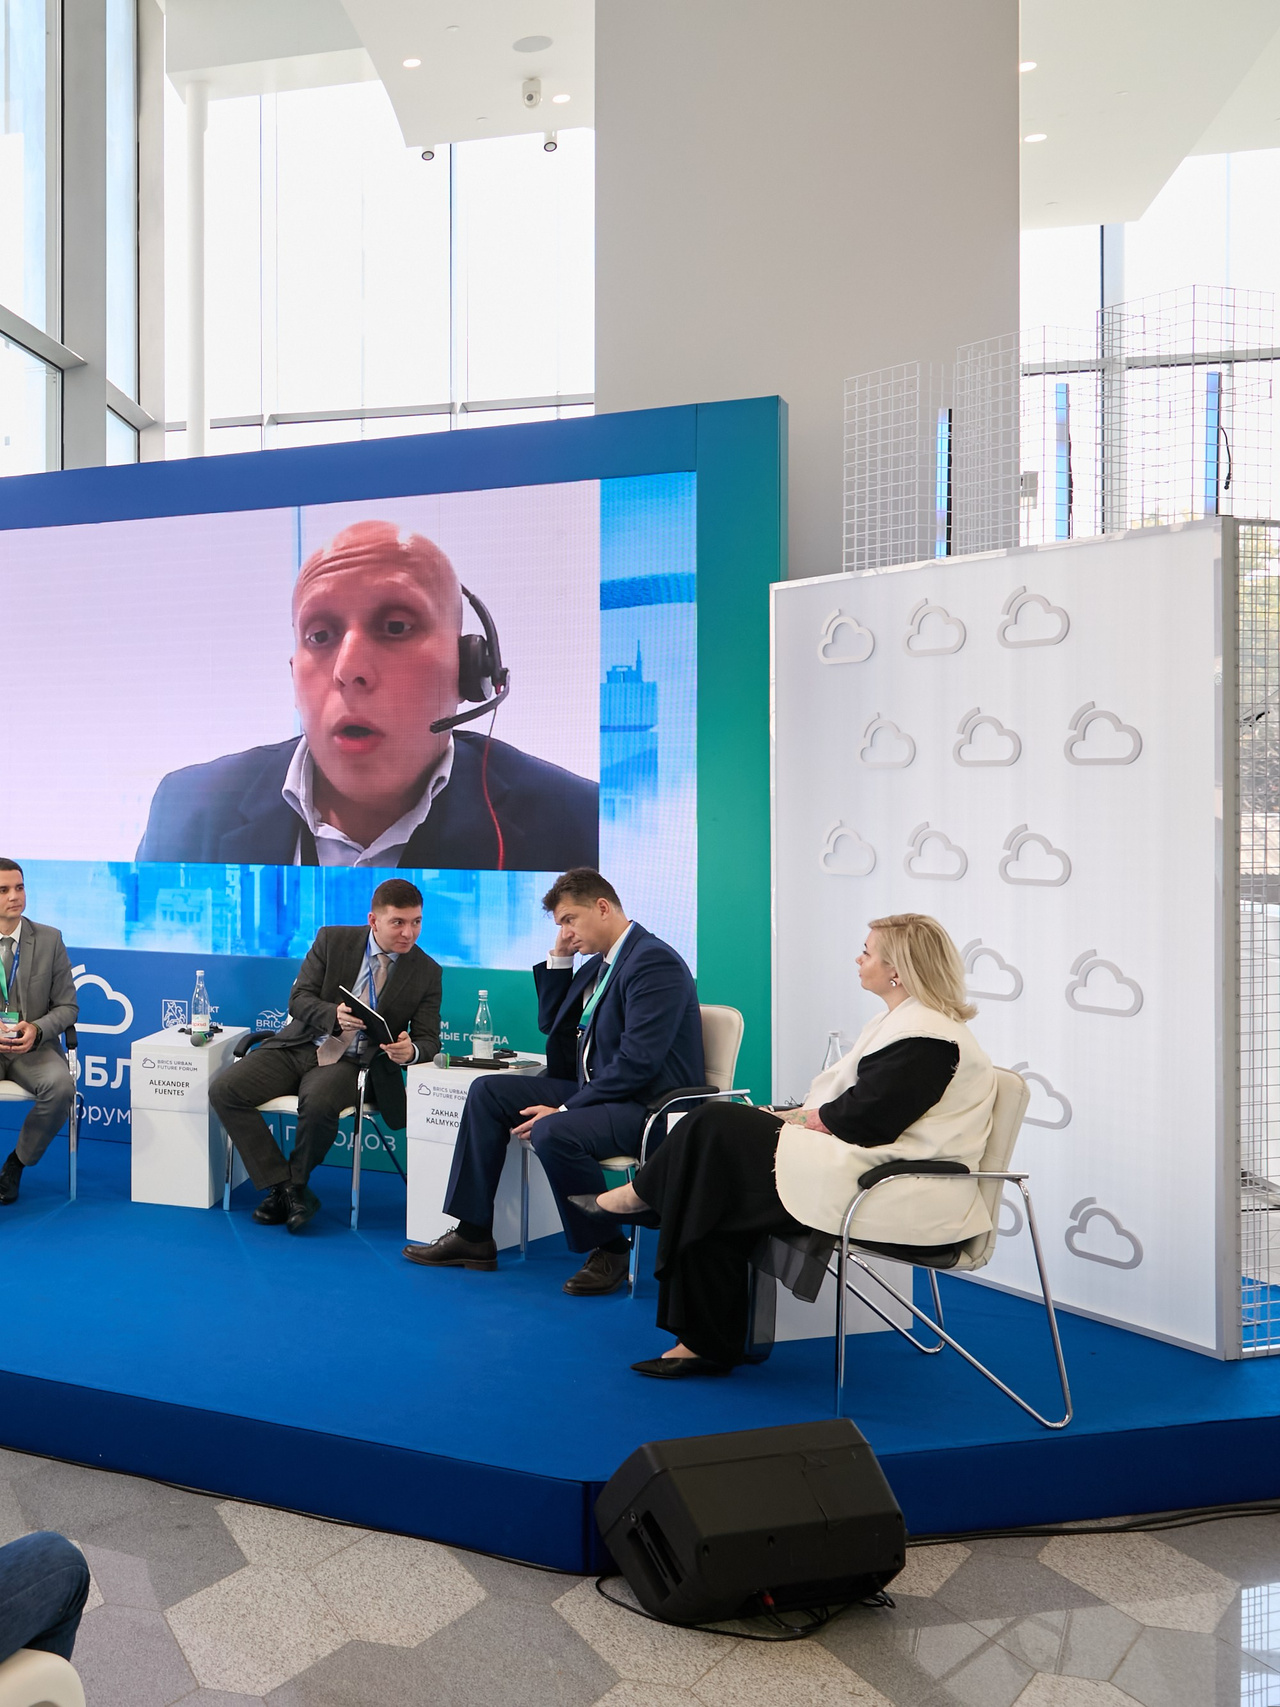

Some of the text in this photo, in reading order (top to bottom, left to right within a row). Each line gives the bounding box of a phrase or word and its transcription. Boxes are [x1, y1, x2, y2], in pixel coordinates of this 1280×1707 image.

[149, 1079, 190, 1088] ALEXANDER
[154, 1088, 185, 1097] FUENTES
[432, 1092, 453, 1100] FUTURE
[431, 1108, 459, 1118] ZAKHAR
[426, 1117, 461, 1128] KALMYKO
